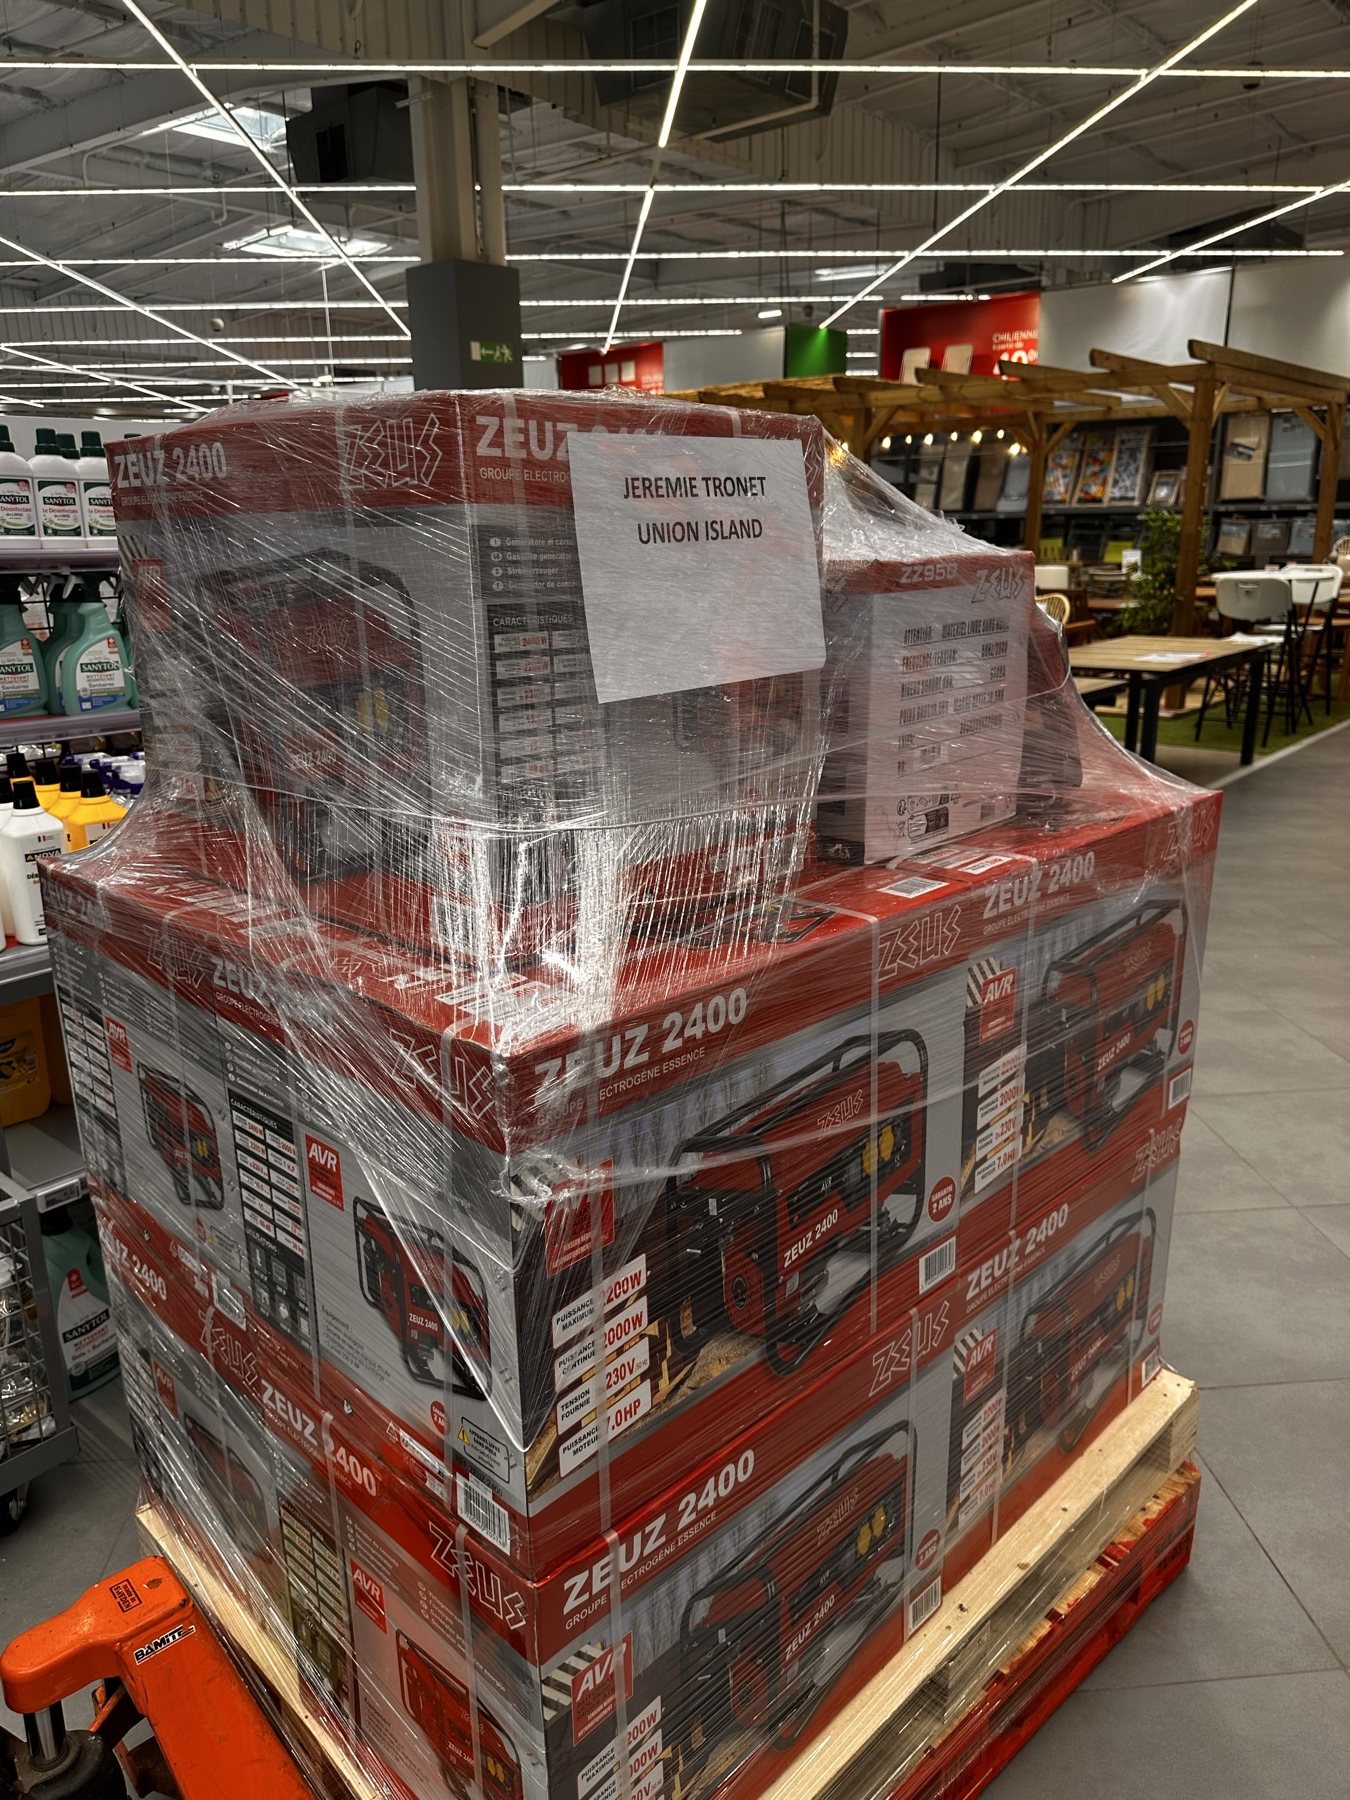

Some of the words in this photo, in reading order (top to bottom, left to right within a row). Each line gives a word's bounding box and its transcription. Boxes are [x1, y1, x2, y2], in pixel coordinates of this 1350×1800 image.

[114, 449, 166, 488] ZEUZ
[172, 442, 227, 485] 2400
[338, 412, 442, 488] ZEUS
[480, 467, 523, 481] GROUPE
[524, 469, 570, 482] ELECTRO
[624, 477, 698, 499] JEREMIE
[702, 476, 766, 497] TRONET
[0, 495, 28, 504] ANYTOL
[638, 520, 699, 545] UNION
[705, 519, 763, 541] ISLAND
[971, 567, 1025, 603] ZEUS
[0, 664, 33, 673] ANYTOL
[983, 869, 1042, 920] ZEUZ
[1047, 851, 1095, 894] 2400
[877, 903, 962, 982] ZEUS
[984, 973, 1014, 1006] AVR
[534, 1023, 651, 1107] ZEUZ
[661, 987, 748, 1054] 2400
[600, 1067, 661, 1101] ECTROGÈNE
[663, 1047, 705, 1074] ESSENCE
[817, 1088, 864, 1140] ZEUS
[308, 1142, 338, 1172] AVR
[937, 1193, 952, 1212] ANS
[784, 1232, 813, 1268] ZEUZ
[815, 1208, 839, 1240] 2400
[966, 1238, 1021, 1301] ZEUZ
[1025, 1203, 1069, 1254] 2400
[132, 1255, 168, 1301] 2400
[64, 1312, 109, 1340] SANYTOL
[409, 1313, 425, 1326] ZEUZ
[425, 1319, 438, 1332] 2400
[869, 1301, 950, 1398] ZEUS
[967, 1334, 994, 1372] AVR
[156, 1368, 173, 1390] AVR
[261, 1379, 318, 1446] ZEUZ
[560, 1387, 590, 1412] TENSION
[561, 1397, 590, 1421] FOURNIE
[563, 1514, 666, 1616] ZEUZ
[677, 1449, 755, 1532] 2400
[354, 1568, 381, 1599] AVR
[429, 1520, 526, 1630] ZEUS
[565, 1594, 607, 1631] GROUPE
[678, 1511, 717, 1546] ESSENCE
[114, 1585, 132, 1608] SWEDEN
[785, 1621, 812, 1661] ZEUZ
[813, 1594, 836, 1628] 2400
[581, 1747, 615, 1780] PUISSANCE
[628, 1710, 658, 1746] 200W
[586, 1754, 615, 1783] MAXIMUM
